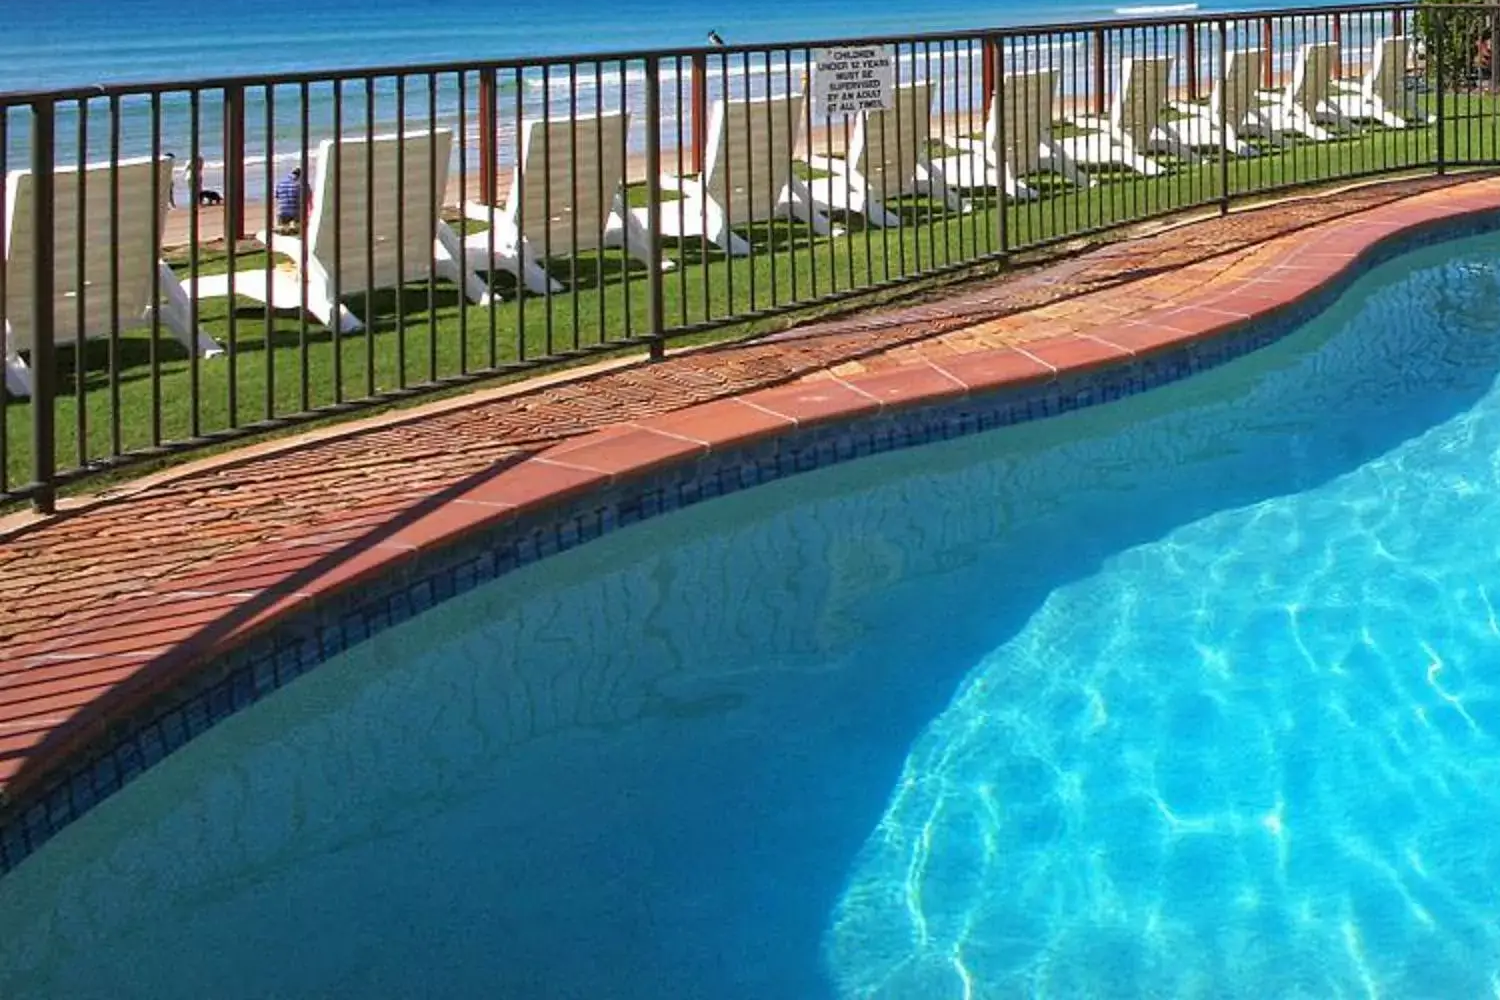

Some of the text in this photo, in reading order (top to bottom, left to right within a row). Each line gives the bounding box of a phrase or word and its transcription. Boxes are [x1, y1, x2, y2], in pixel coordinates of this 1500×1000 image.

[834, 50, 875, 60] CHILDREN
[818, 62, 848, 71] UNDER
[864, 60, 889, 68] YEARS
[830, 81, 881, 90] SUPERVISED
[828, 90, 881, 102] BY AN ADULT
